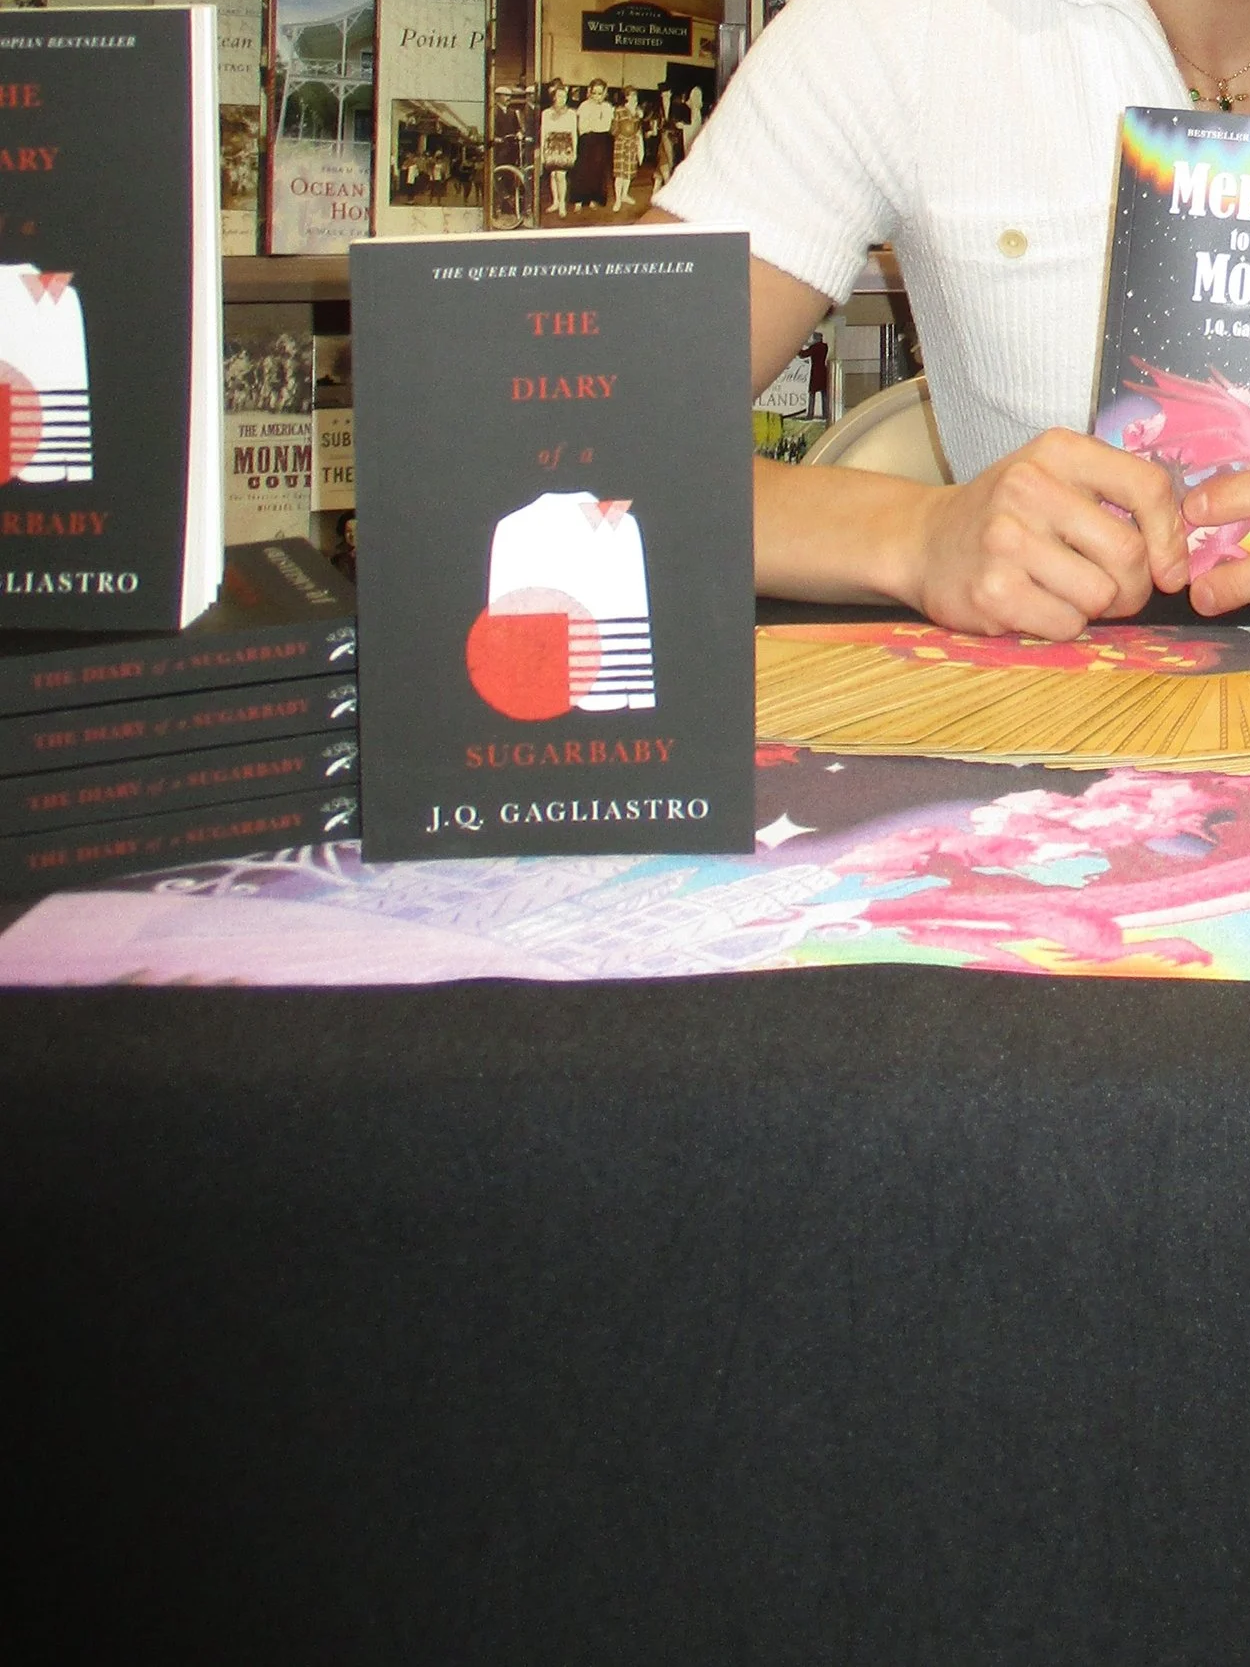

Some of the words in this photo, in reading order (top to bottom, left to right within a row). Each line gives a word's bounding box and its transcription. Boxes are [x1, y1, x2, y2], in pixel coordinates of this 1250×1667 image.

[400, 27, 457, 50] Point
[588, 20, 615, 32] WEST
[619, 22, 646, 34] LONG
[649, 24, 688, 36] BRANCH
[48, 35, 136, 49] BESTSELLER
[1186, 127, 1250, 143] BESTSELLER
[290, 177, 365, 199] OCEAN
[1229, 227, 1250, 252] to
[432, 266, 463, 280] THE
[467, 264, 518, 281] QUEER
[521, 262, 602, 278] DYSTOPIAN
[604, 261, 695, 276] BESTSELLER
[526, 310, 601, 337] THE
[1203, 318, 1231, 338] J.Q.
[510, 374, 618, 402] DIARY
[239, 424, 257, 438] THE
[261, 422, 312, 437] AMERICAN
[233, 444, 312, 475] MONM
[537, 440, 568, 471] of
[579, 448, 595, 466] a
[464, 736, 676, 769] SUGARBABY
[425, 804, 486, 833] J.Q.
[499, 797, 710, 825] GAGLIASTRO
